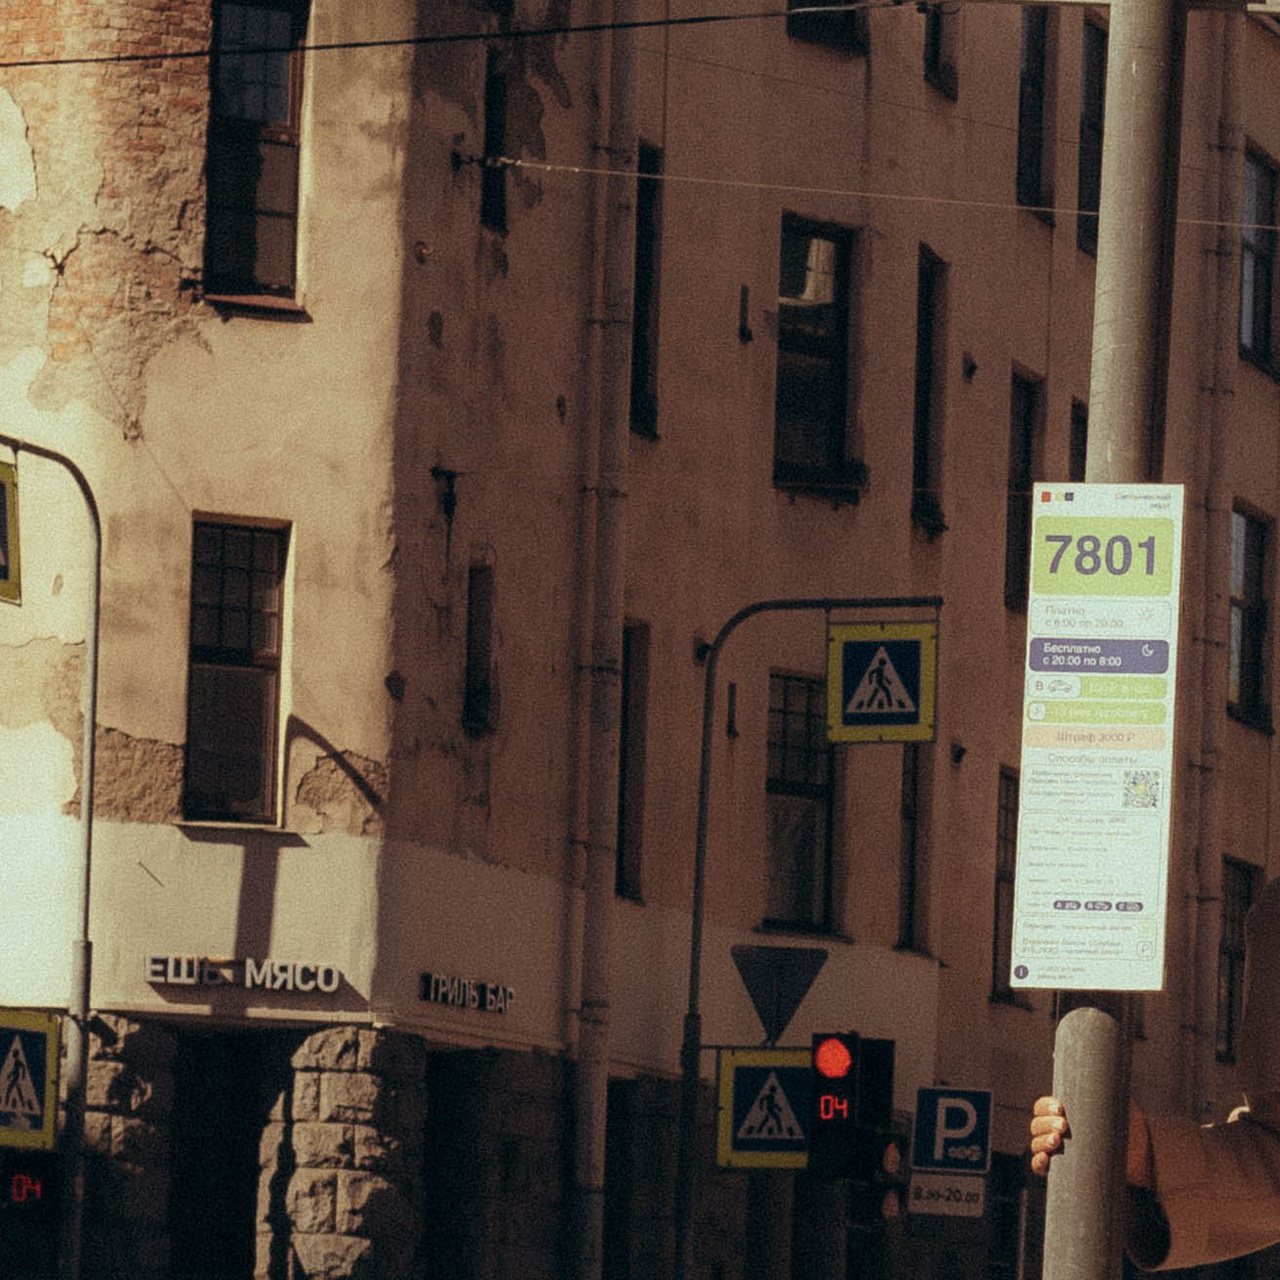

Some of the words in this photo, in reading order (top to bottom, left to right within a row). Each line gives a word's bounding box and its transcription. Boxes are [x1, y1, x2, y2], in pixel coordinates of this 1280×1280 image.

[1045, 534, 1156, 575] 7801
[1043, 642, 1101, 654] Бесплатно
[1043, 657, 1050, 665] с
[1083, 657, 1097, 666] по
[1057, 731, 1096, 744] Штраф
[145, 956, 223, 985] ЕШЬ
[245, 958, 340, 993] МЯСО
[431, 973, 479, 1009] ГРИЛЬ
[487, 982, 515, 1014] БАР
[820, 1095, 848, 1119] 04
[11, 1174, 42, 1202] 04
